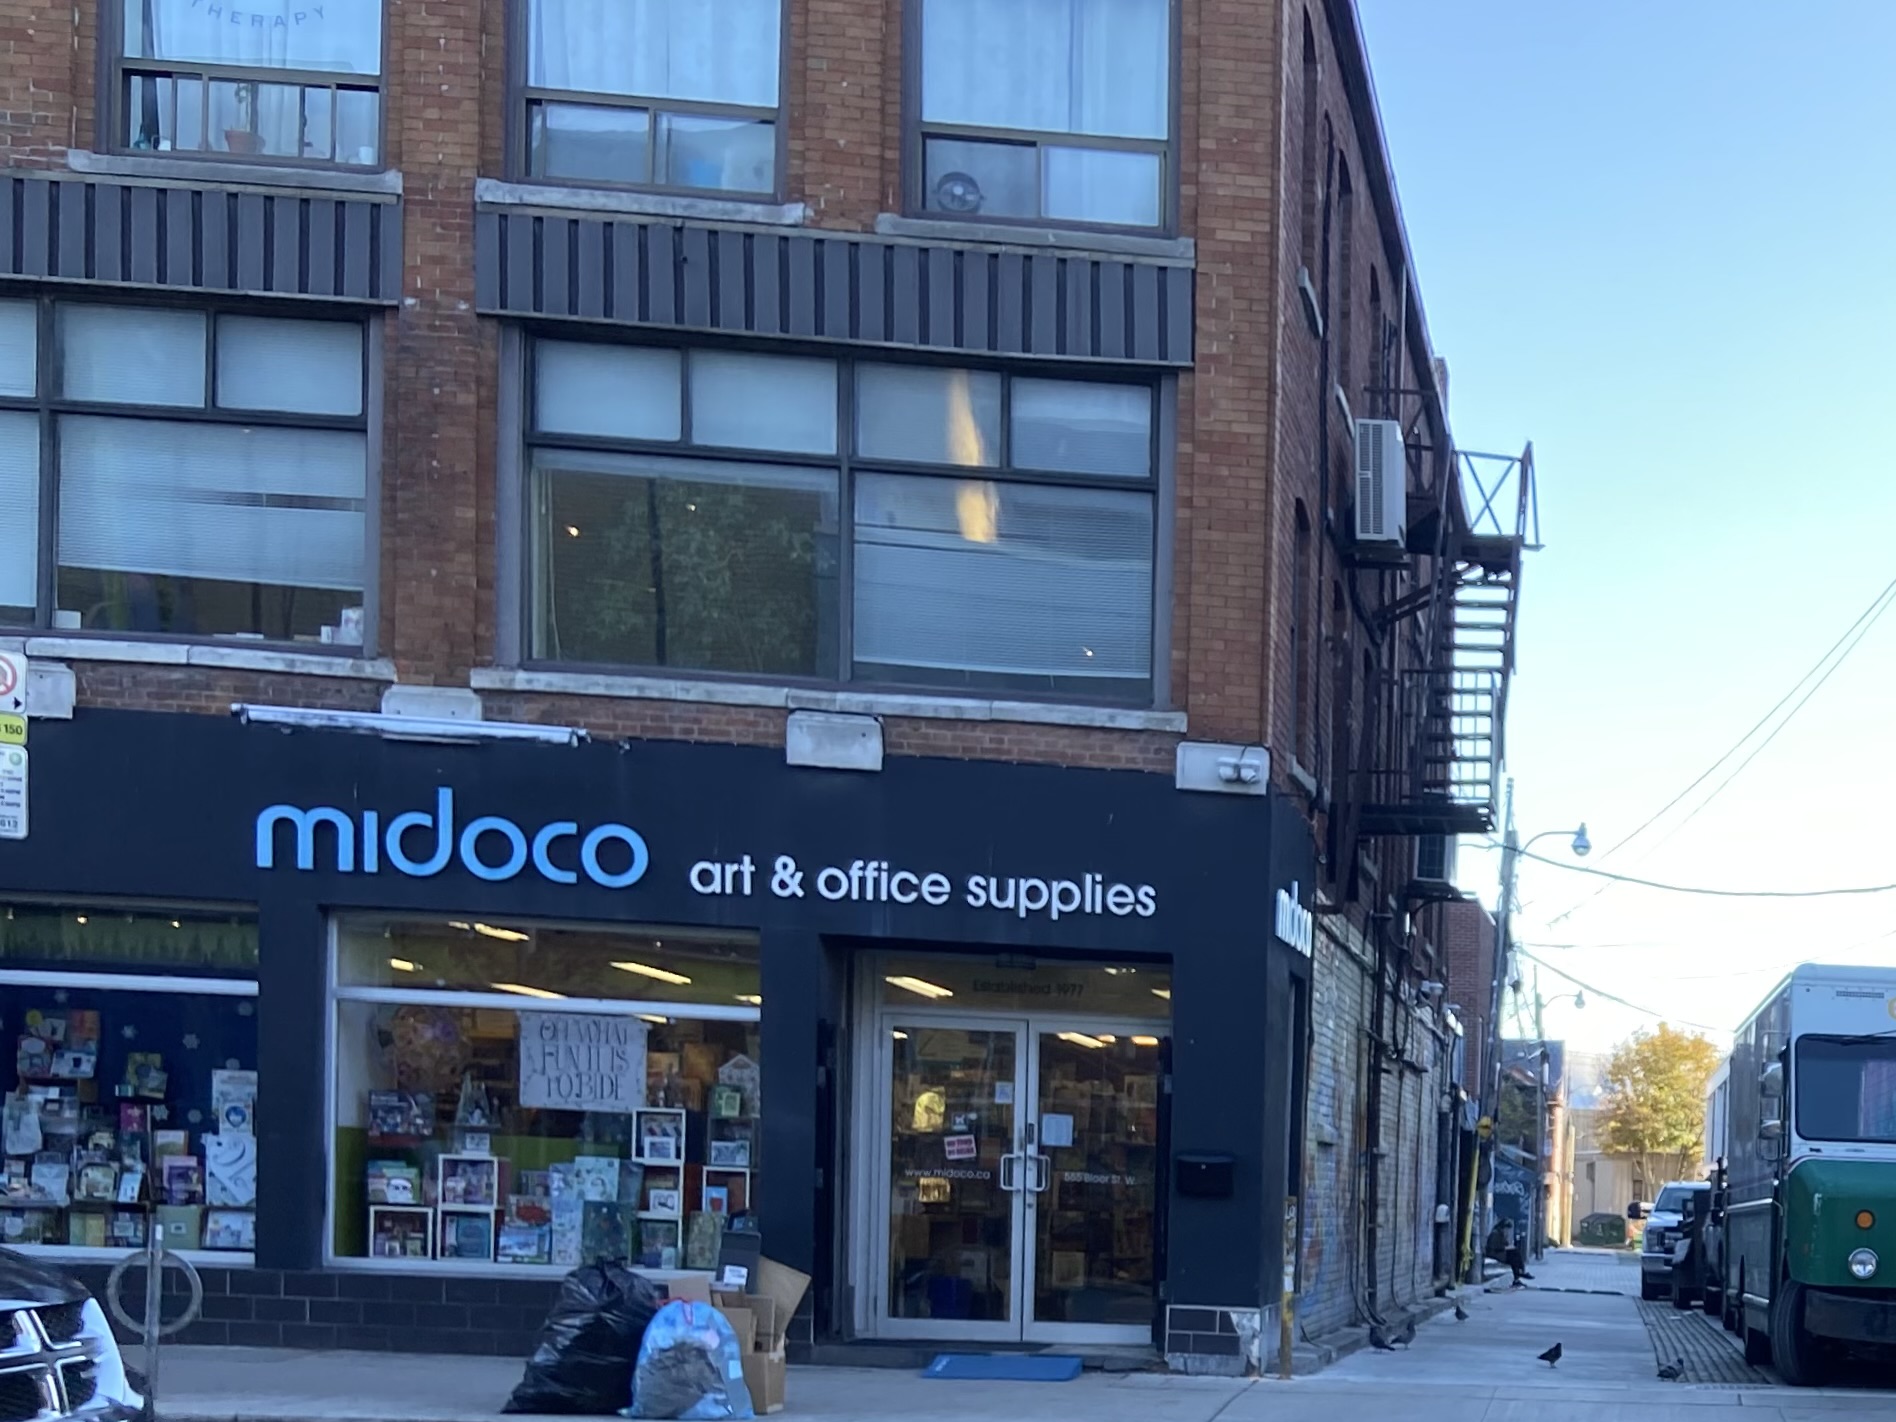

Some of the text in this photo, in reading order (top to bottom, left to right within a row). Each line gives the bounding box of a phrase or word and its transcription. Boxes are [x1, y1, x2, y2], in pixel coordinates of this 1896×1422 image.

[256, 786, 650, 889] midoco
[689, 855, 1157, 920] art & office supplies
